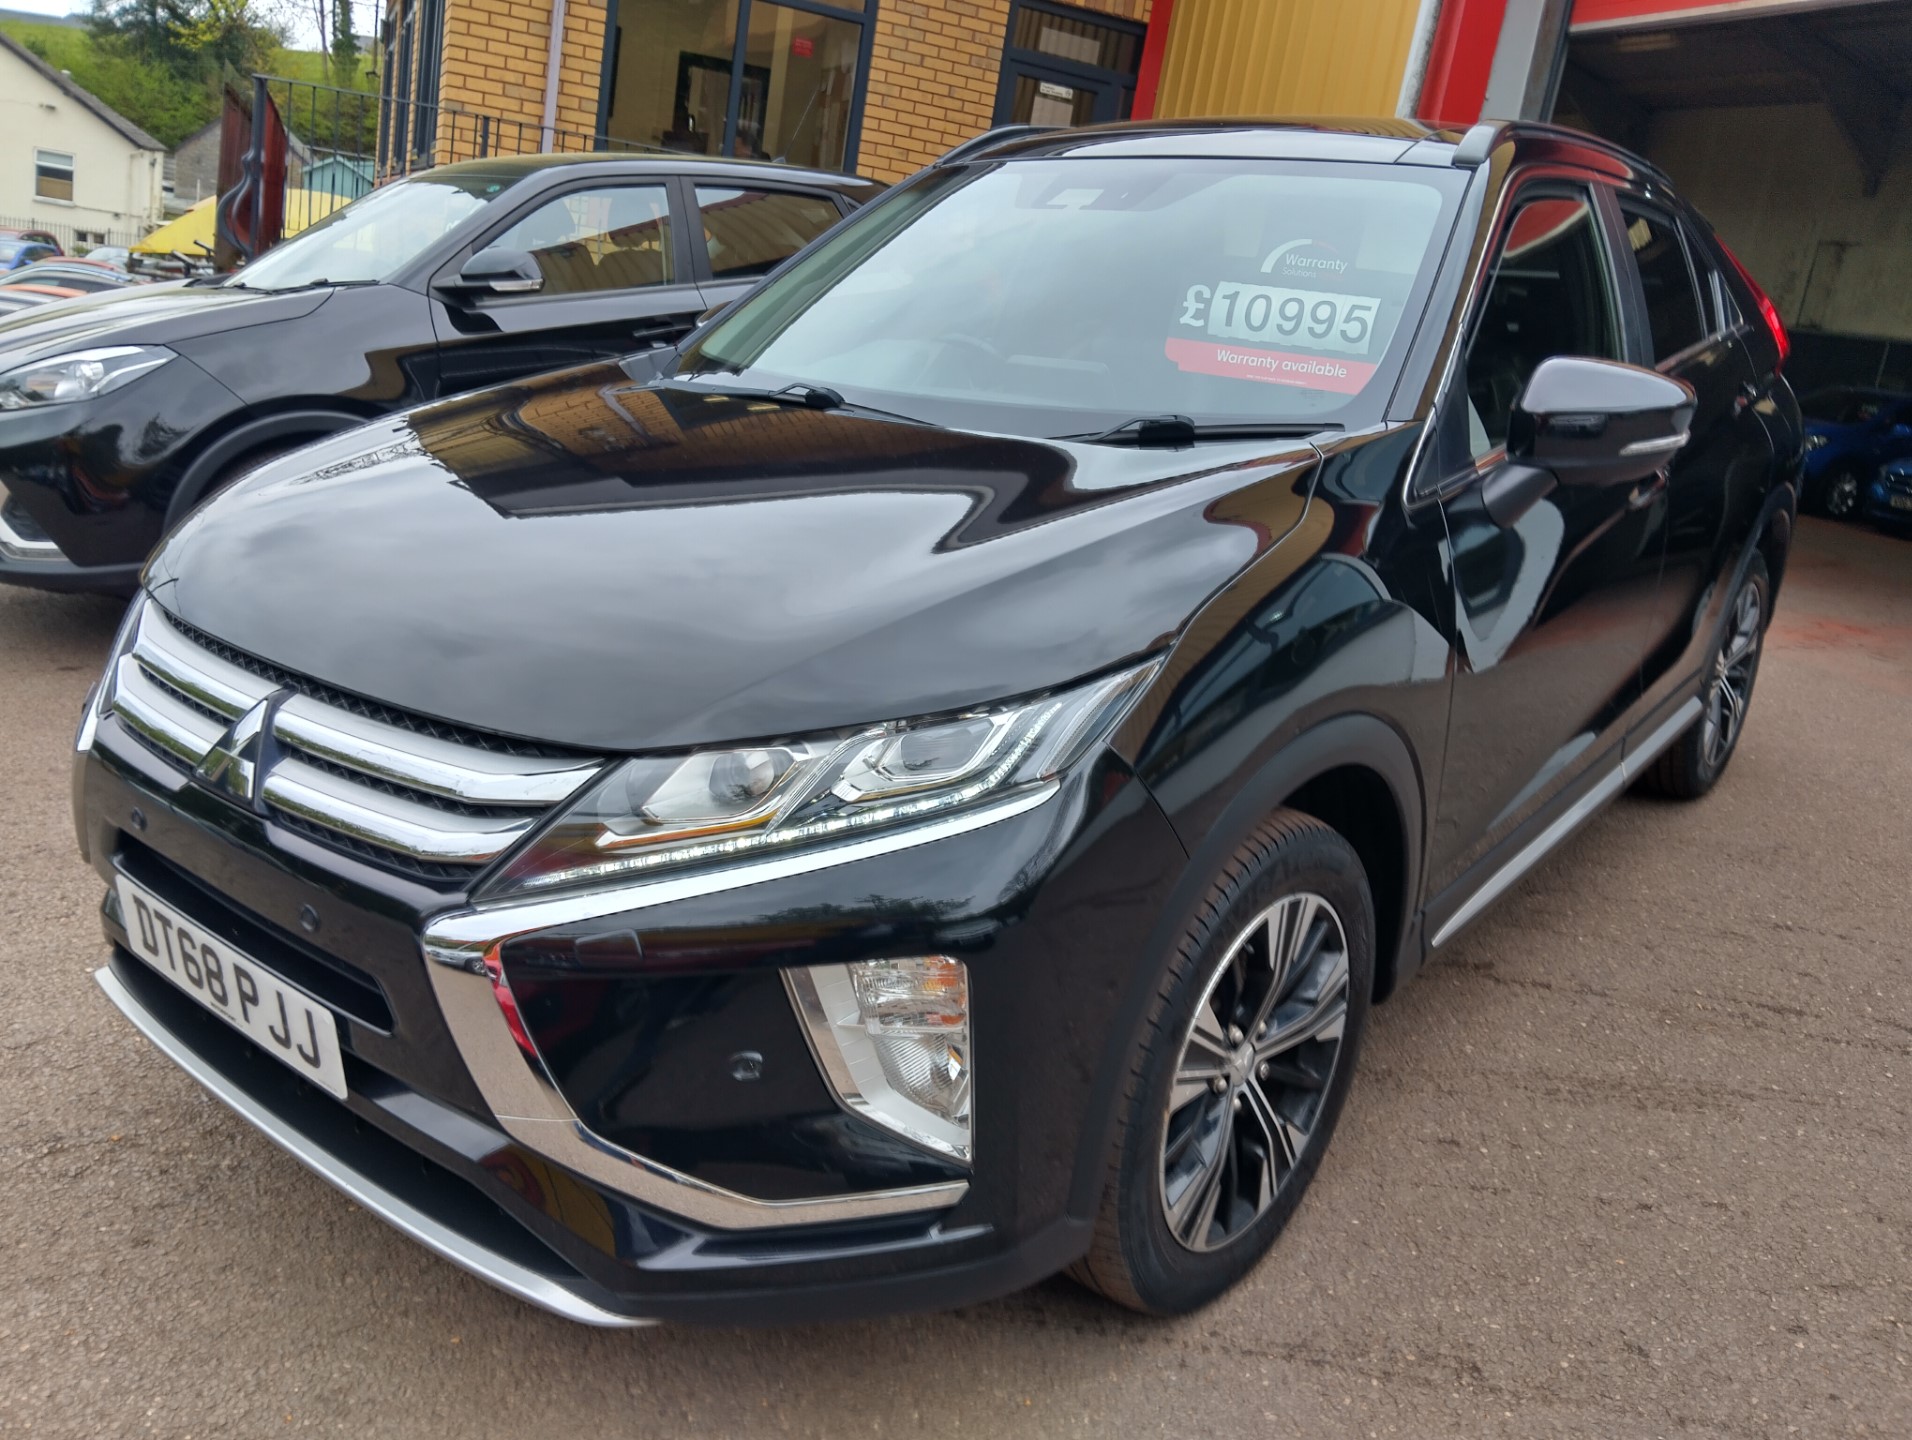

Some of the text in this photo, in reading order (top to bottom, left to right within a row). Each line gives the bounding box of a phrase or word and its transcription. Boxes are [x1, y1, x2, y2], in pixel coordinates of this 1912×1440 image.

[1286, 253, 1348, 274] Warranty
[1179, 284, 1373, 348] £10995
[1217, 349, 1347, 378] Warranty available
[132, 894, 321, 1069] DT68 PJJ
